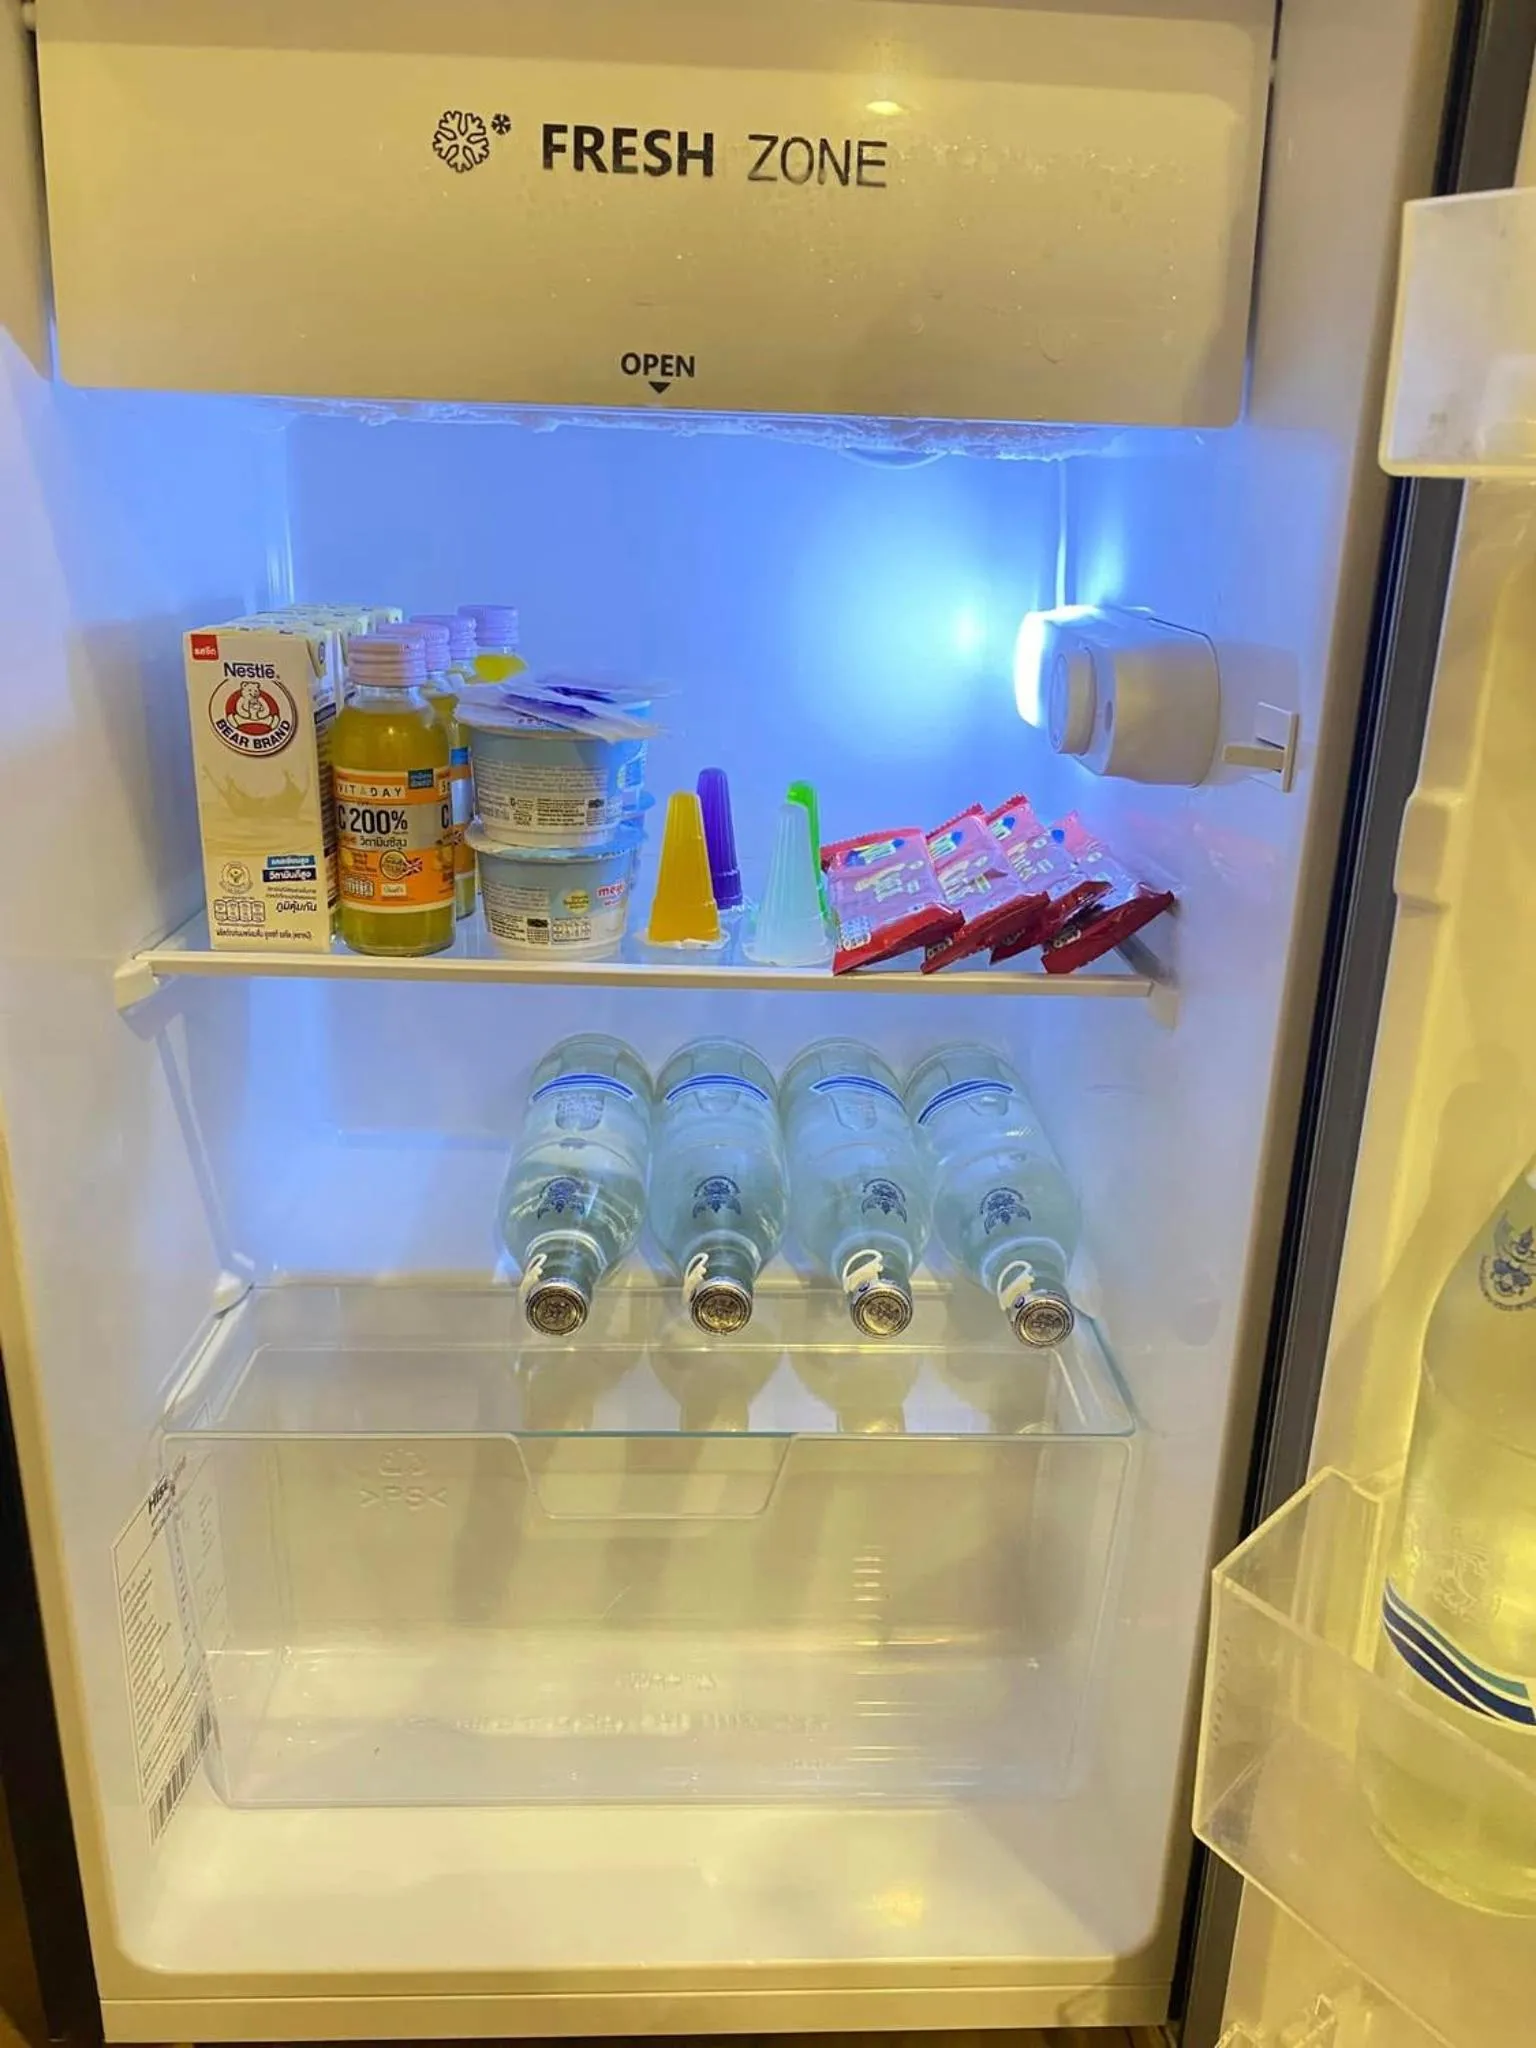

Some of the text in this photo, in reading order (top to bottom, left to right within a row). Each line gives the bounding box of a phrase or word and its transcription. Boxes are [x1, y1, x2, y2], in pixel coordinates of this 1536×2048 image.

[542, 123, 888, 189] FRESH ZONE
[620, 352, 695, 378] OPEN
[216, 719, 291, 750] BEAR BRAND
[370, 787, 402, 797] DAY
